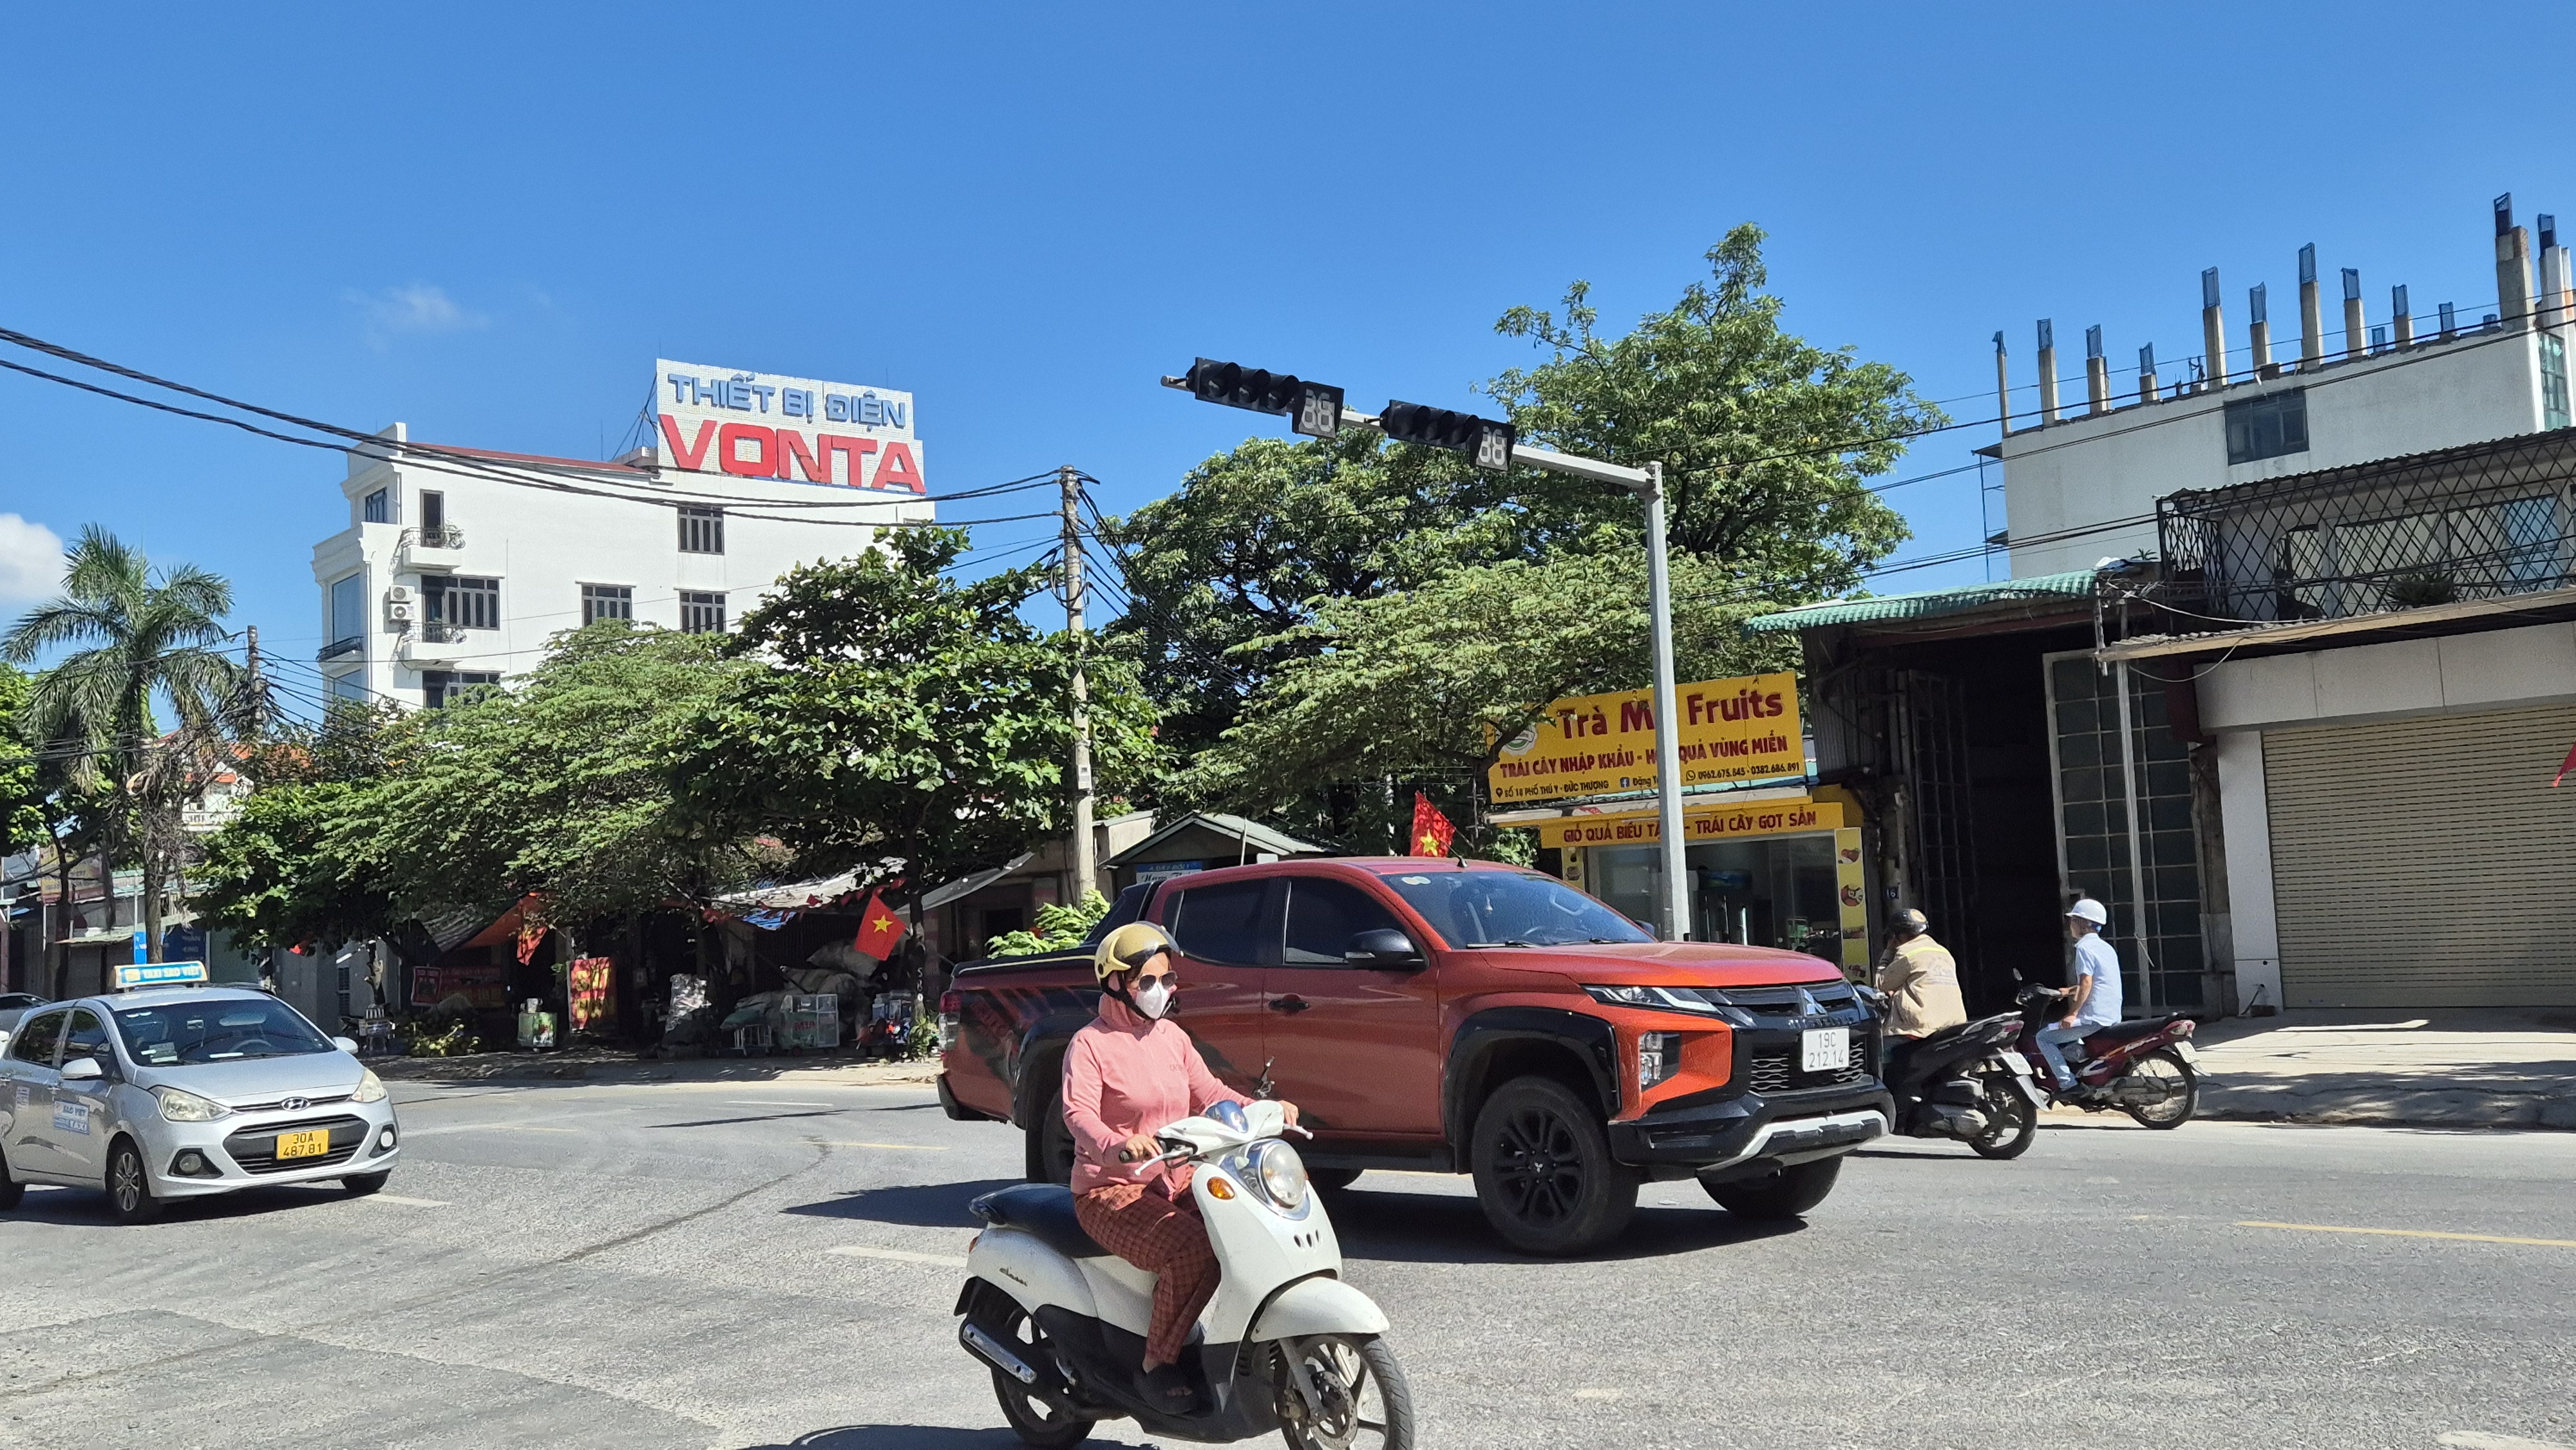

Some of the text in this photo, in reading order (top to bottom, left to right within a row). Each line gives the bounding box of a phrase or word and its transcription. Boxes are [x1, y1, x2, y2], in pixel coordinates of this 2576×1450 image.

[668, 372, 905, 431] THIẾT BỊ ĐIỆN
[658, 414, 926, 493] VONTA
[1557, 689, 1784, 739] Trà M Fruits
[1500, 758, 1530, 778] TRÁI
[1533, 757, 1557, 776] CÂY
[1560, 751, 1595, 775] NHẬP
[1598, 744, 1634, 769] KHẨU
[1709, 737, 1748, 758] VÙNG
[1752, 730, 1788, 754] MIỀN
[1617, 822, 1642, 840] BIẾU
[1695, 816, 1724, 834] TRÁI
[1729, 813, 1753, 831] CÂY
[1759, 813, 1783, 832] GỌT
[1819, 1031, 1836, 1048] 19C
[1809, 1049, 1844, 1068] 212.14
[292, 1133, 313, 1144] 30A
